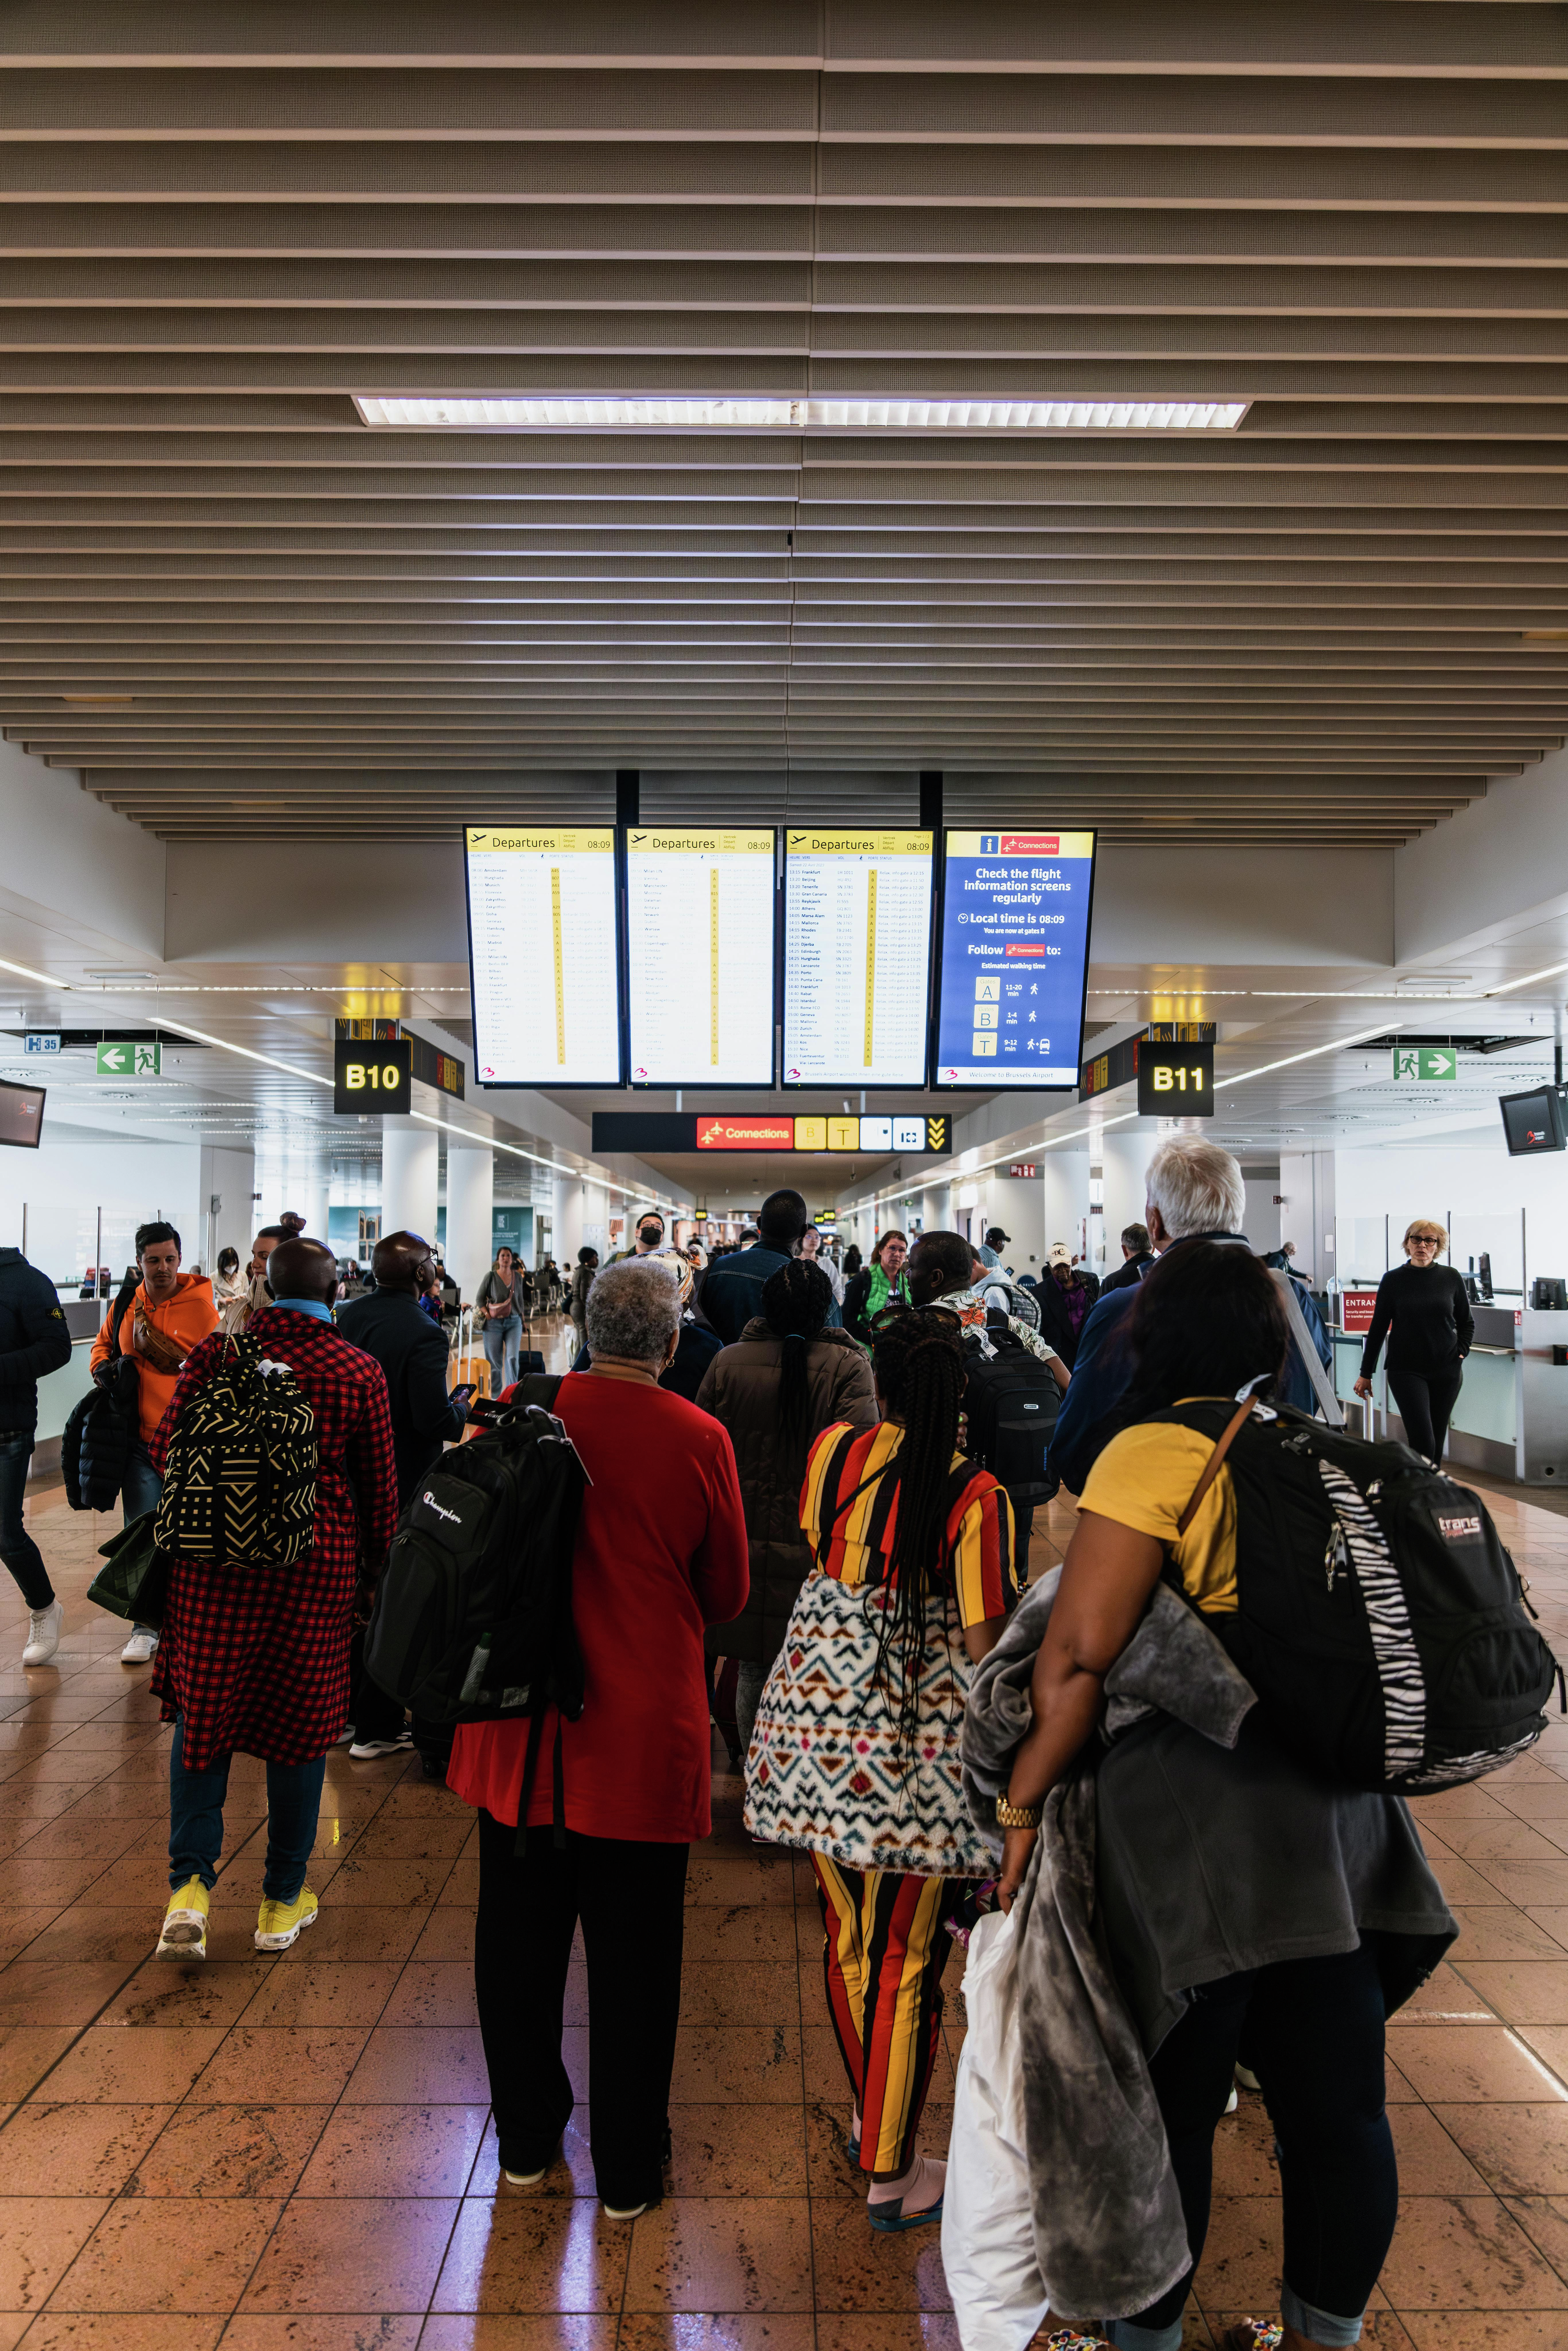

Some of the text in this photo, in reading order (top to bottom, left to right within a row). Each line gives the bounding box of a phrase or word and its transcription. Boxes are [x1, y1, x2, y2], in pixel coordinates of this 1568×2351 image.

[493, 838, 555, 849] Departures
[653, 839, 714, 850] Departures
[813, 840, 874, 851] Departures
[976, 868, 1061, 881] Check the flight
[965, 879, 1071, 892] information screens
[993, 892, 1042, 905] regularly
[971, 913, 1065, 924] Local time is 08:09
[969, 944, 1004, 955] Follow
[1046, 946, 1060, 955] to:
[982, 986, 992, 998] A
[981, 1013, 990, 1025] B
[43, 1039, 57, 1050] 35
[980, 1041, 990, 1053] T
[346, 1065, 399, 1089] B10
[1154, 1067, 1203, 1090] B11
[725, 1127, 790, 1139] Connections
[806, 1127, 814, 1137] B
[837, 1130, 849, 1145] T
[977, 1329, 989, 1349] CCEPED
[423, 1491, 462, 1524] Champion
[1438, 1517, 1480, 1534] trans
